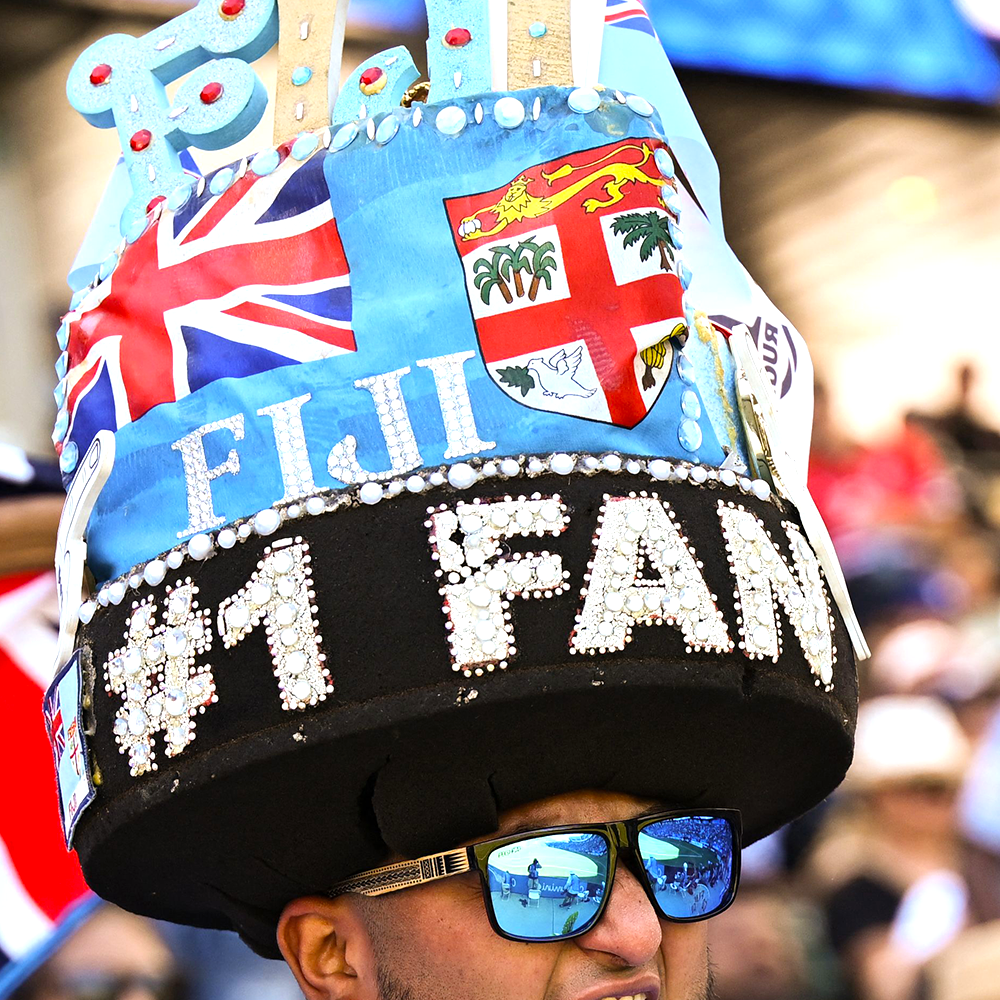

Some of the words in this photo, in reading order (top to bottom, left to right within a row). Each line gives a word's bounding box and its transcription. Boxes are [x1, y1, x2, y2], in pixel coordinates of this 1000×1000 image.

[170, 350, 497, 538] FIJI
[104, 536, 335, 777] #1
[424, 490, 839, 692] FAN
